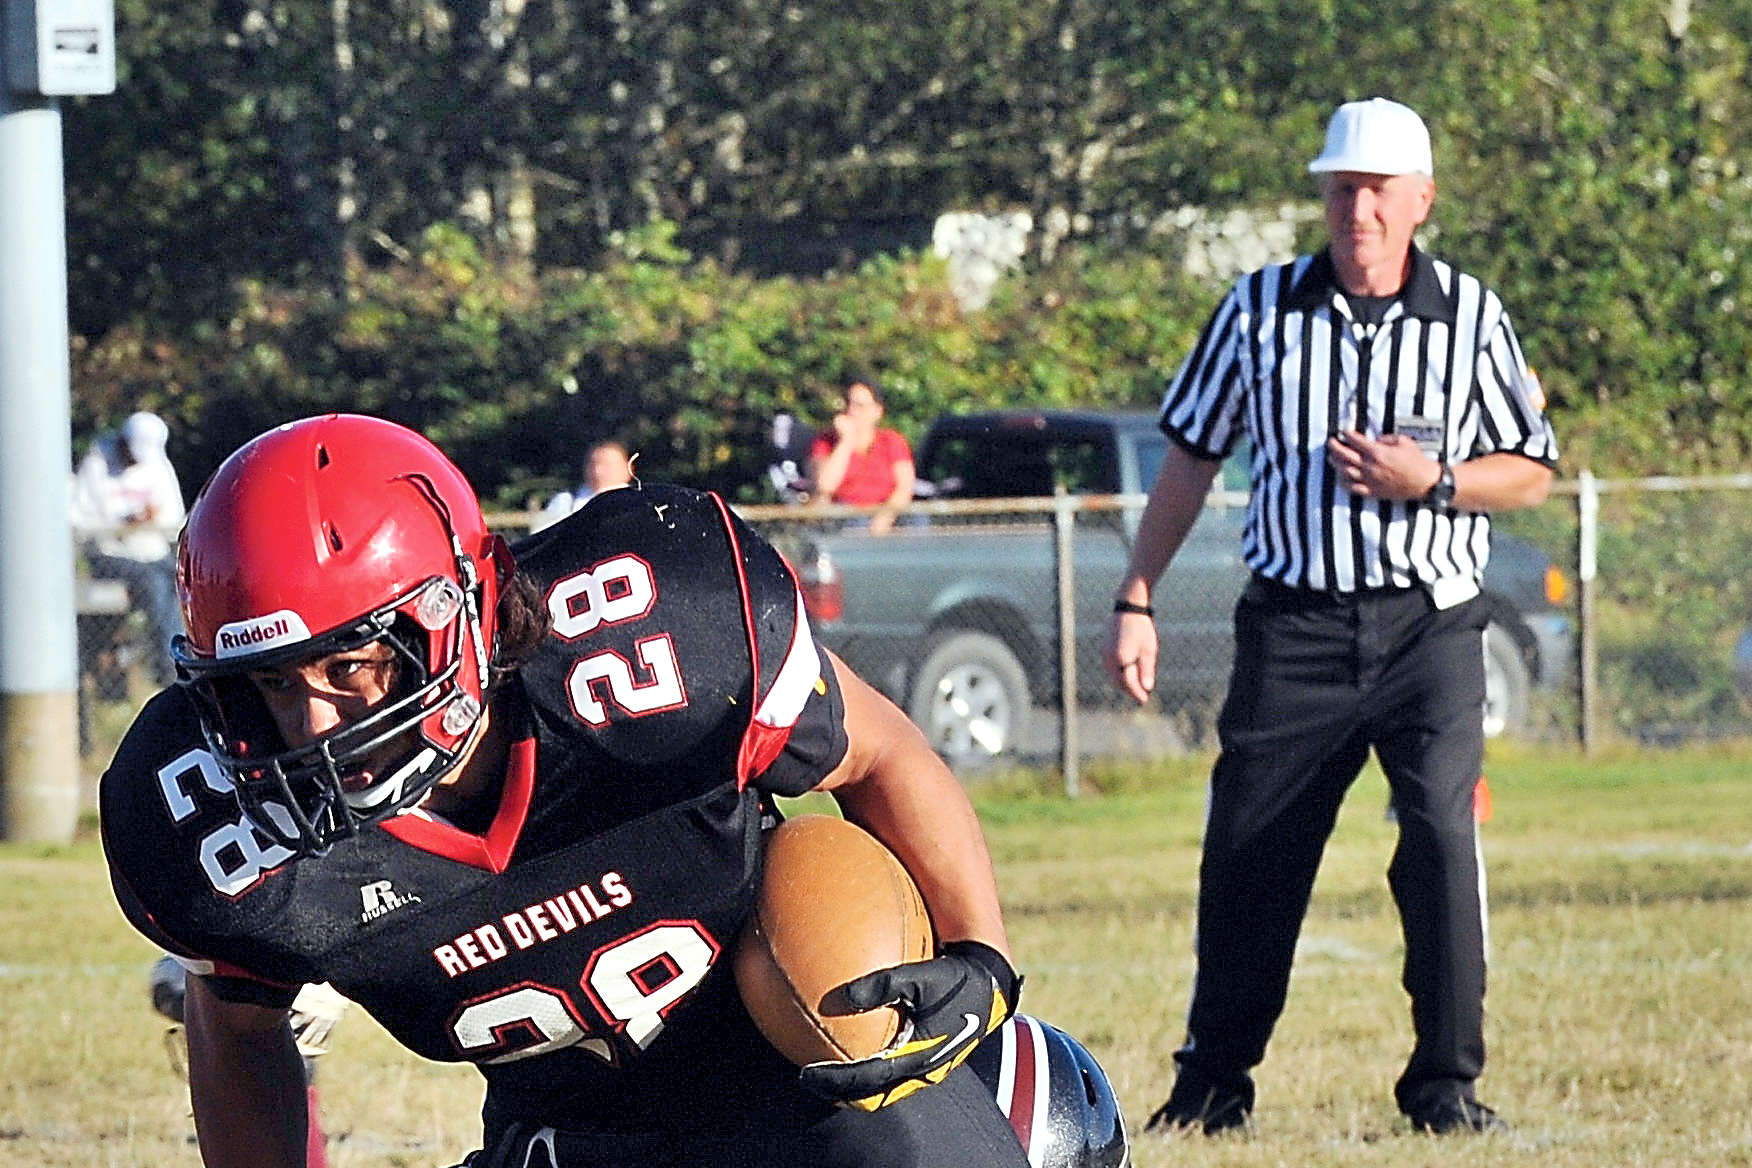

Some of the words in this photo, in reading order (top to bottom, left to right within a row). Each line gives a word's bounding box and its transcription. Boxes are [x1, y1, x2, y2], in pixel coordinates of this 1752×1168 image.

[220, 618, 290, 650] Riddell
[546, 552, 689, 730] 28
[433, 923, 508, 979] RED
[502, 871, 636, 951] DEVILS
